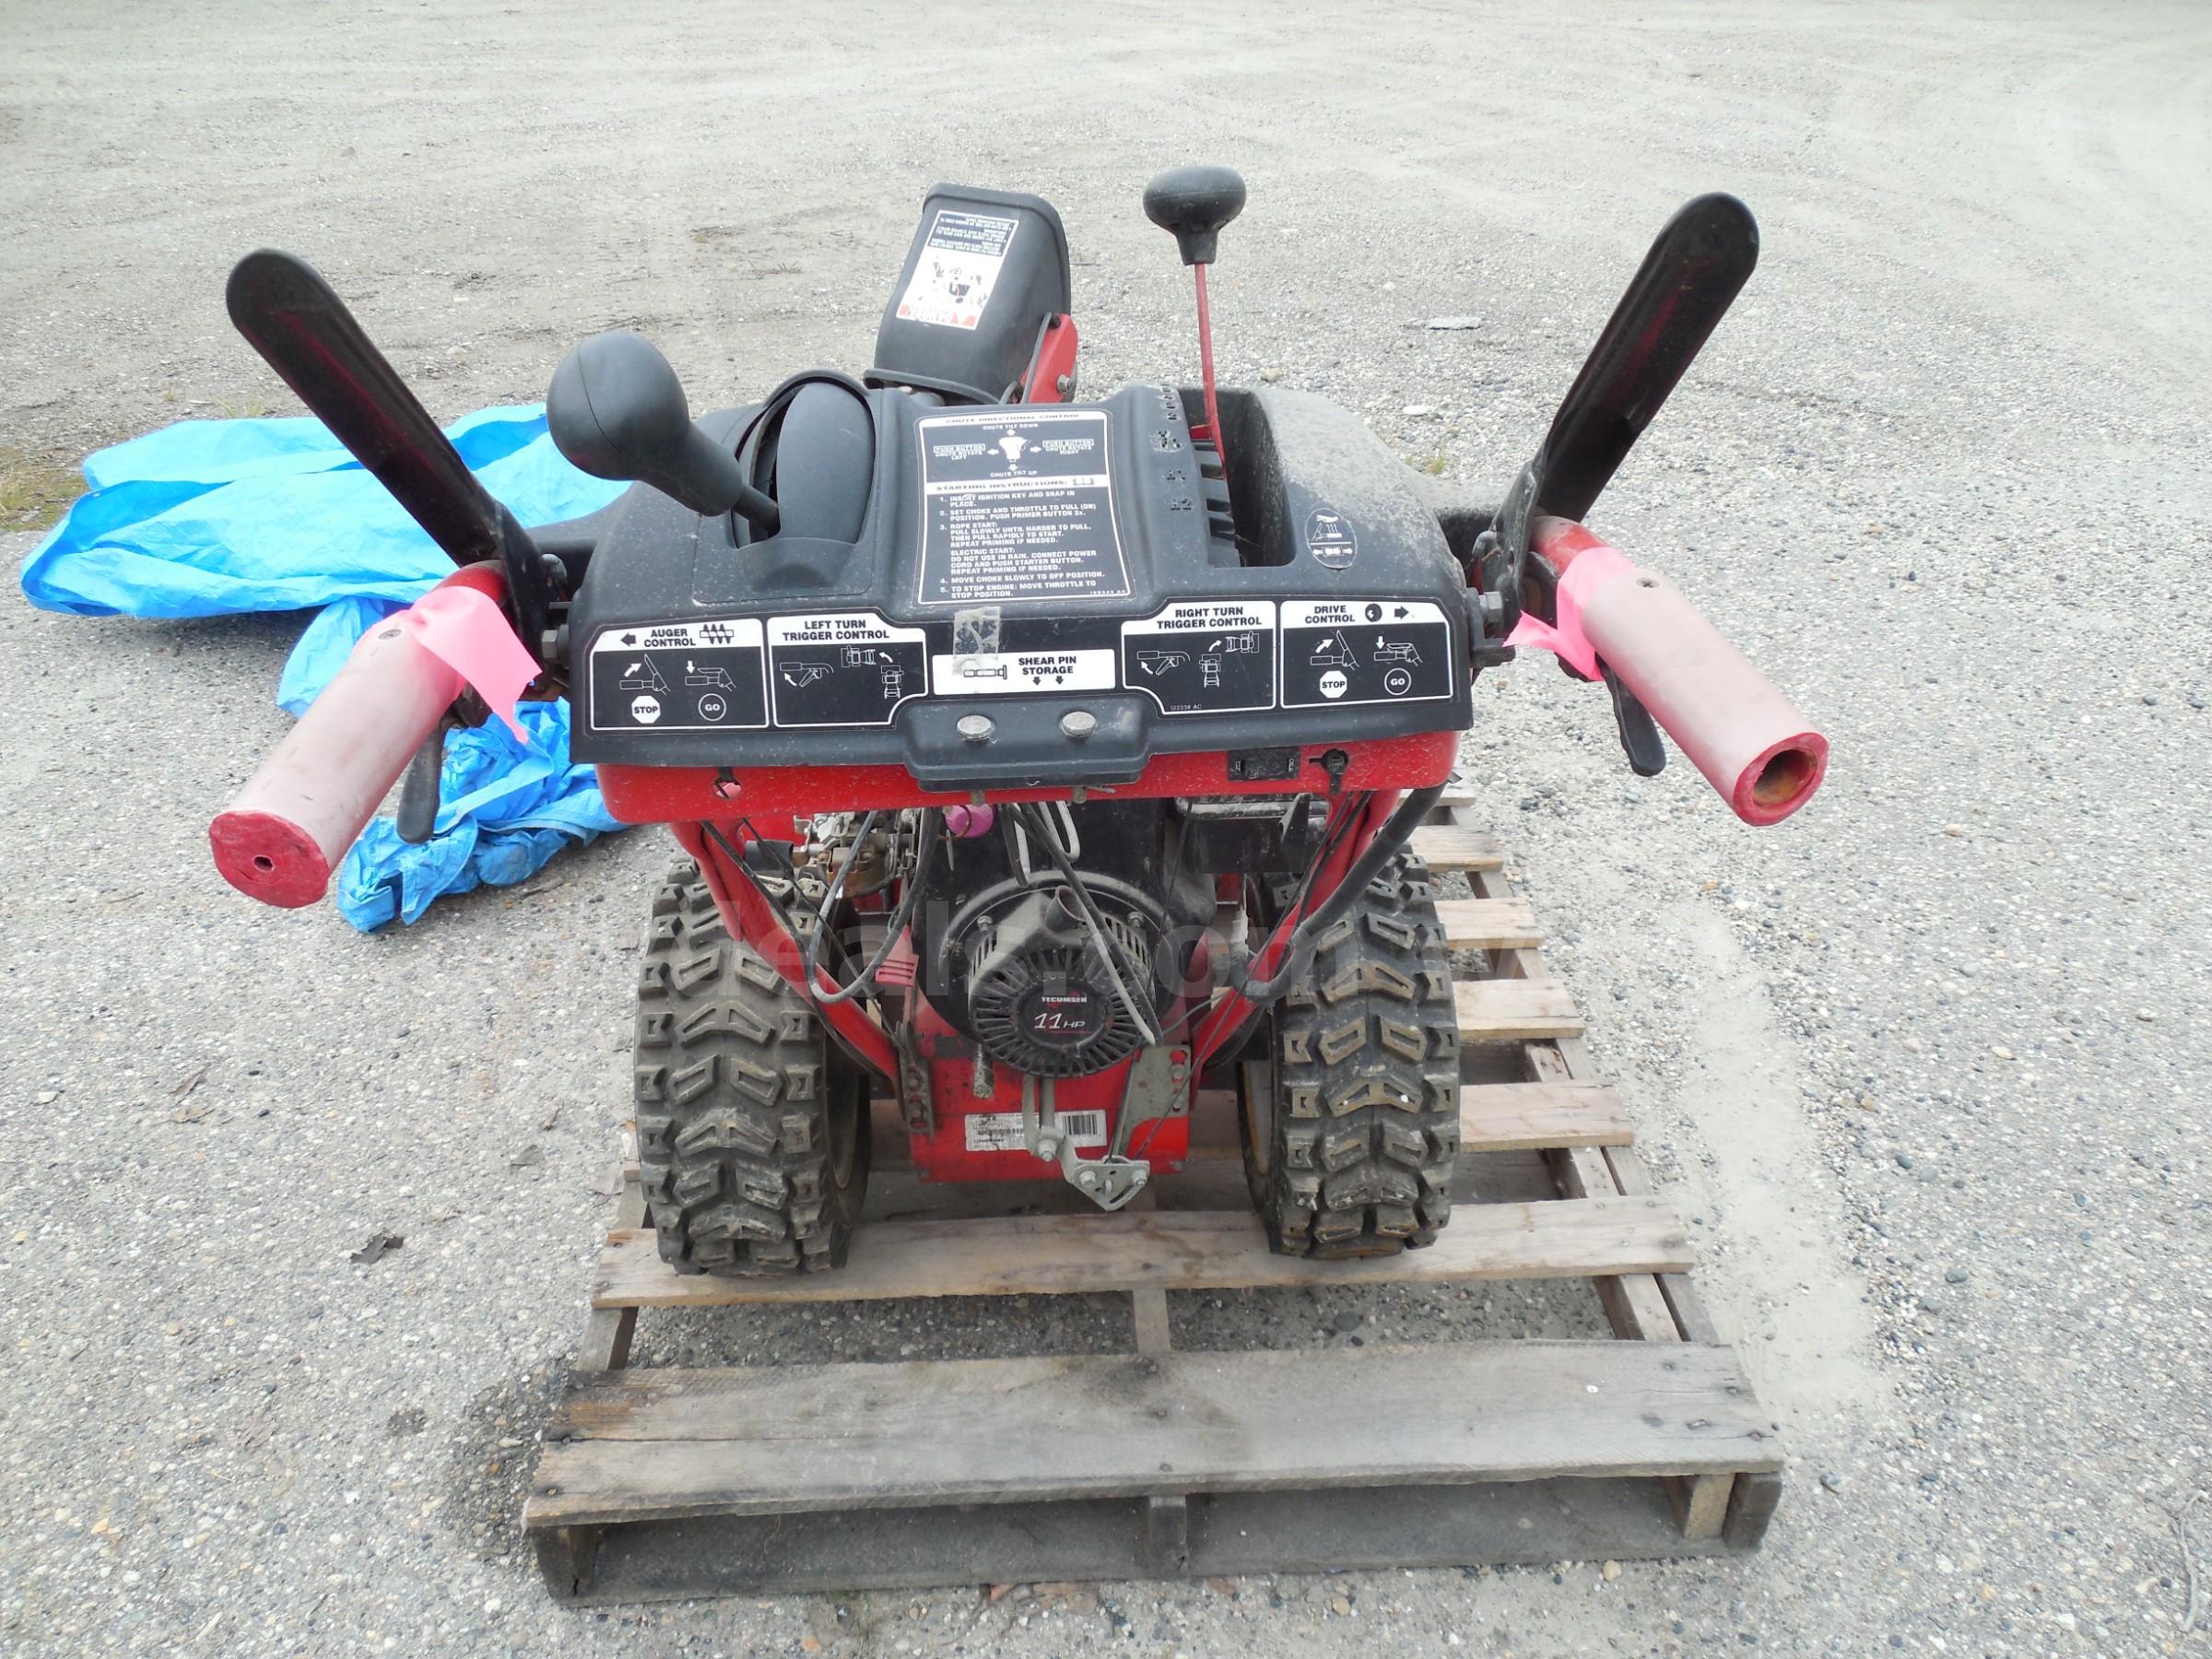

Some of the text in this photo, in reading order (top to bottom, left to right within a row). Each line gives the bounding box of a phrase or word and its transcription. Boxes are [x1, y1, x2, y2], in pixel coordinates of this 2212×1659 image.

[1175, 606, 1243, 618] RIGHT TURN
[1314, 605, 1347, 615] DRIVE
[804, 619, 866, 630] LEFT TURN
[1157, 616, 1263, 629] TRIGGER CONTROL
[1304, 613, 1356, 625] CONTROL
[650, 629, 688, 639] AUGER
[782, 629, 890, 642] TRIGGER CONTROL
[643, 637, 697, 648] CONTROL
[1018, 655, 1077, 666] SHEAR PIN
[1022, 665, 1074, 676] STORAGE
[1322, 679, 1346, 689] STOP
[1390, 677, 1406, 686] GO
[633, 705, 659, 714] STOP
[704, 703, 721, 712] GO
[1034, 1013, 1086, 1030] 11 HP
